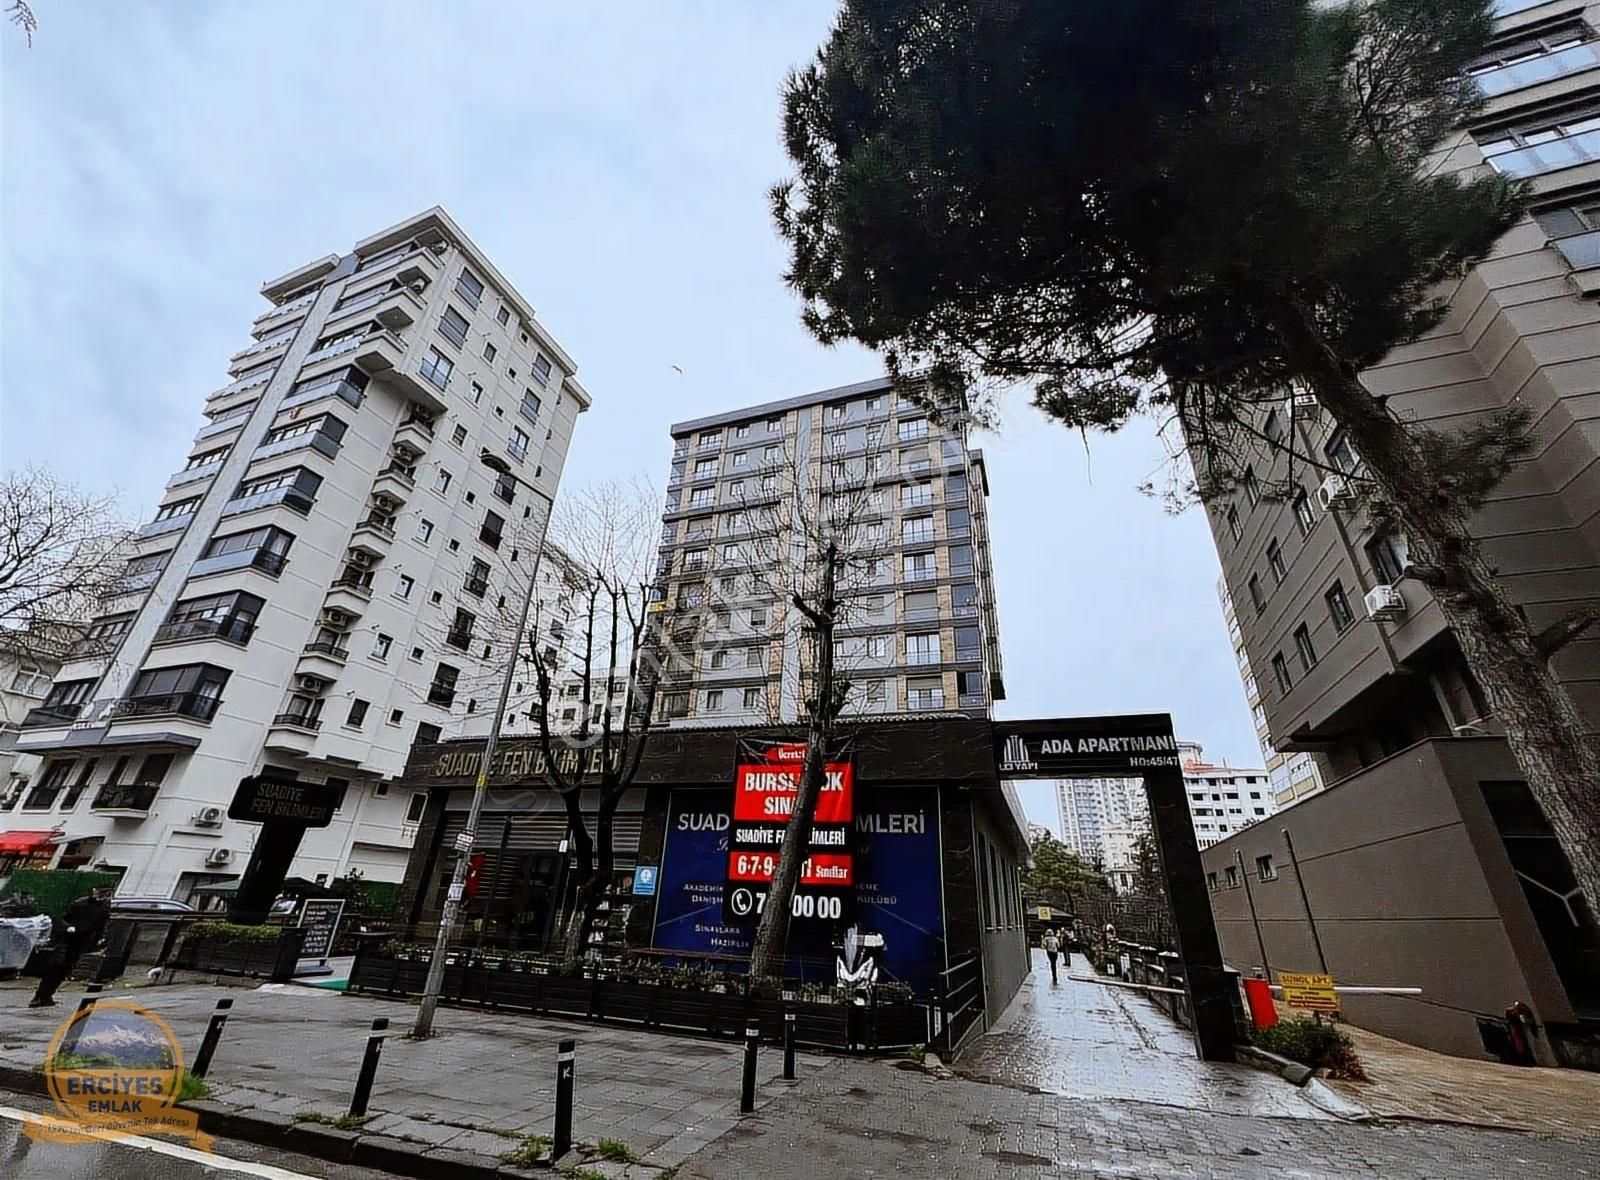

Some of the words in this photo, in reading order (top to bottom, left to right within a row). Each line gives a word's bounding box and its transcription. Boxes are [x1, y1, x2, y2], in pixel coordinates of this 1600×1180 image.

[1041, 739, 1074, 754] ADA
[1077, 735, 1176, 753] APARTMANI
[436, 752, 498, 776] SUADİE
[501, 752, 532, 775] FEN
[745, 772, 844, 791] BURSLUK
[678, 813, 730, 832] SUAD
[855, 809, 926, 834] MLERİ
[736, 826, 774, 843] SUADİYE
[808, 827, 845, 845] İMLERİ
